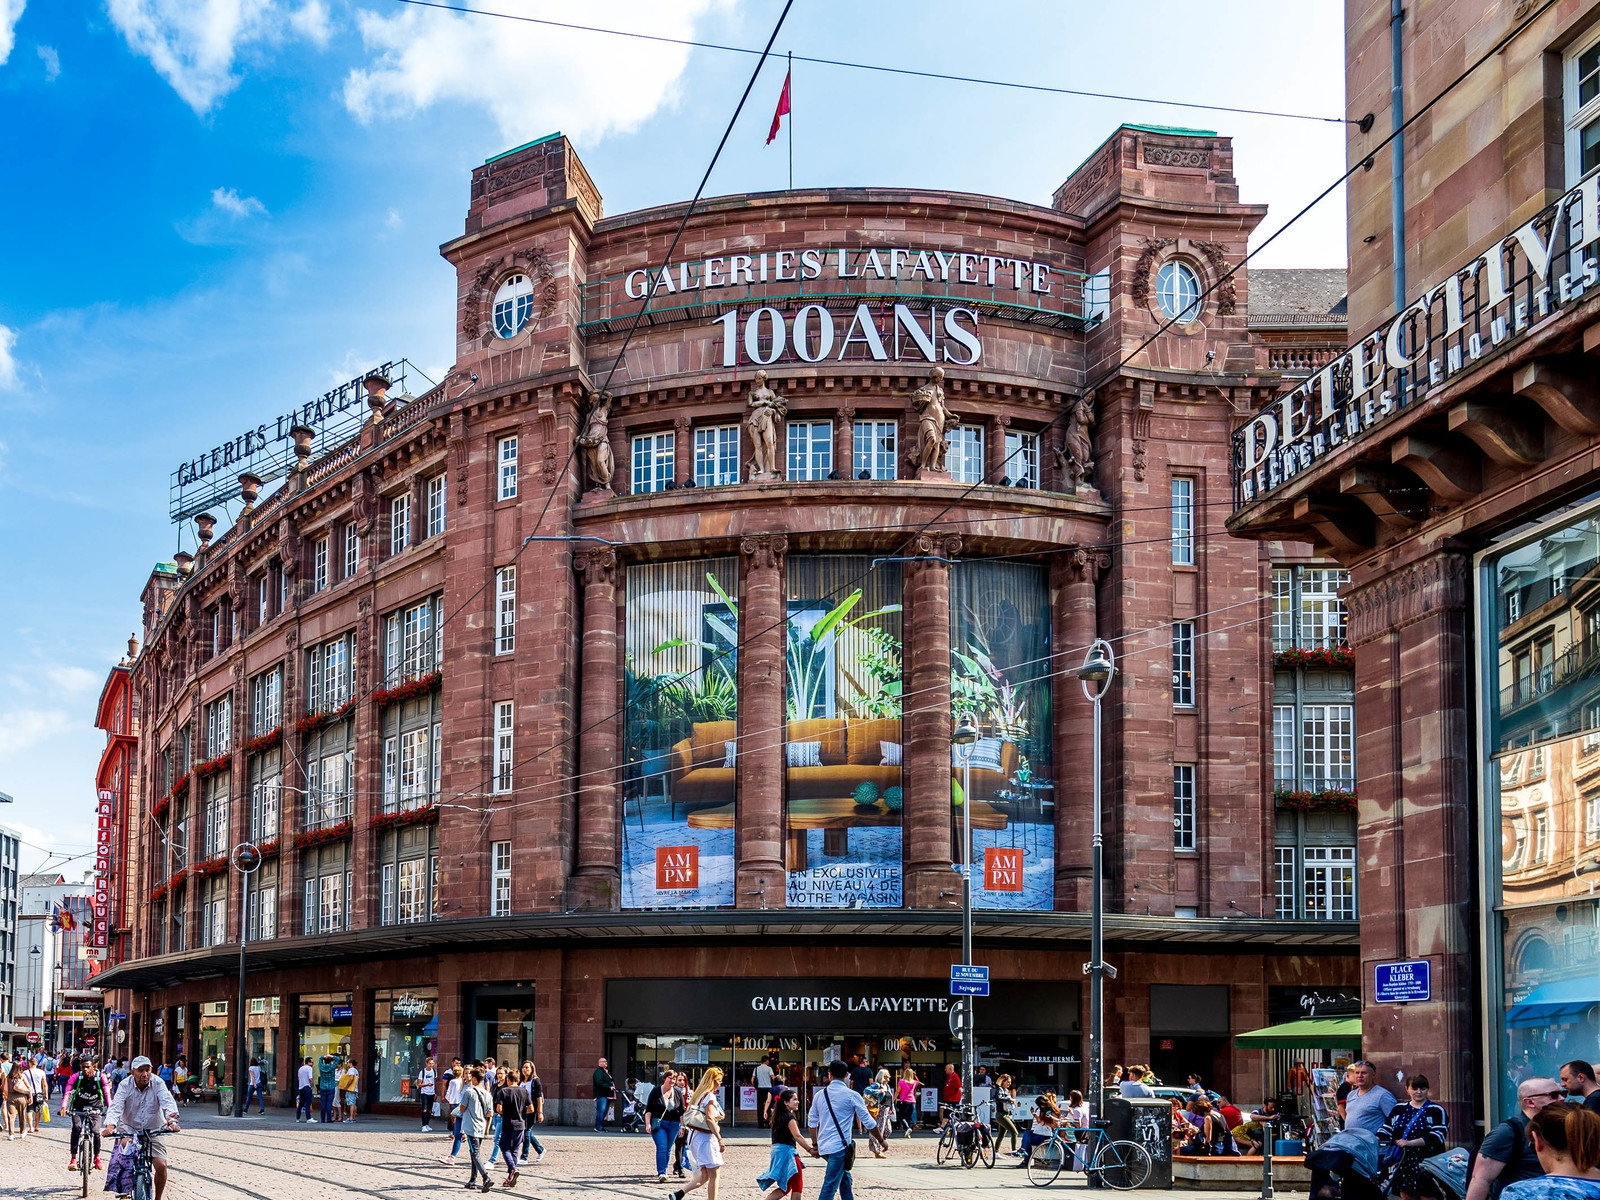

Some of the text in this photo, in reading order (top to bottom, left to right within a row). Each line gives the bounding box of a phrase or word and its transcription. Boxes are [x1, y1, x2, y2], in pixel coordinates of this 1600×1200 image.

[625, 248, 1051, 300] GALERIES LAFAYETTE
[1243, 390, 1393, 501] RECHERCHES
[1430, 257, 1599, 386] ENQUETES
[178, 424, 266, 487] GALERIES
[664, 853, 691, 867] AM
[992, 856, 1016, 869] AM
[665, 869, 691, 882] PM
[790, 868, 807, 878] EN
[992, 871, 1016, 884] PM
[789, 881, 897, 890] AU NIVEAU 4 DE
[789, 893, 898, 903] VOTRE MAGASIN
[1390, 965, 1413, 974] PLACE
[1389, 973, 1414, 982] KLEBER
[751, 997, 949, 1012] GALERIES LAFAYETTE
[742, 1037, 766, 1050] 100
[884, 1038, 900, 1051] 100
